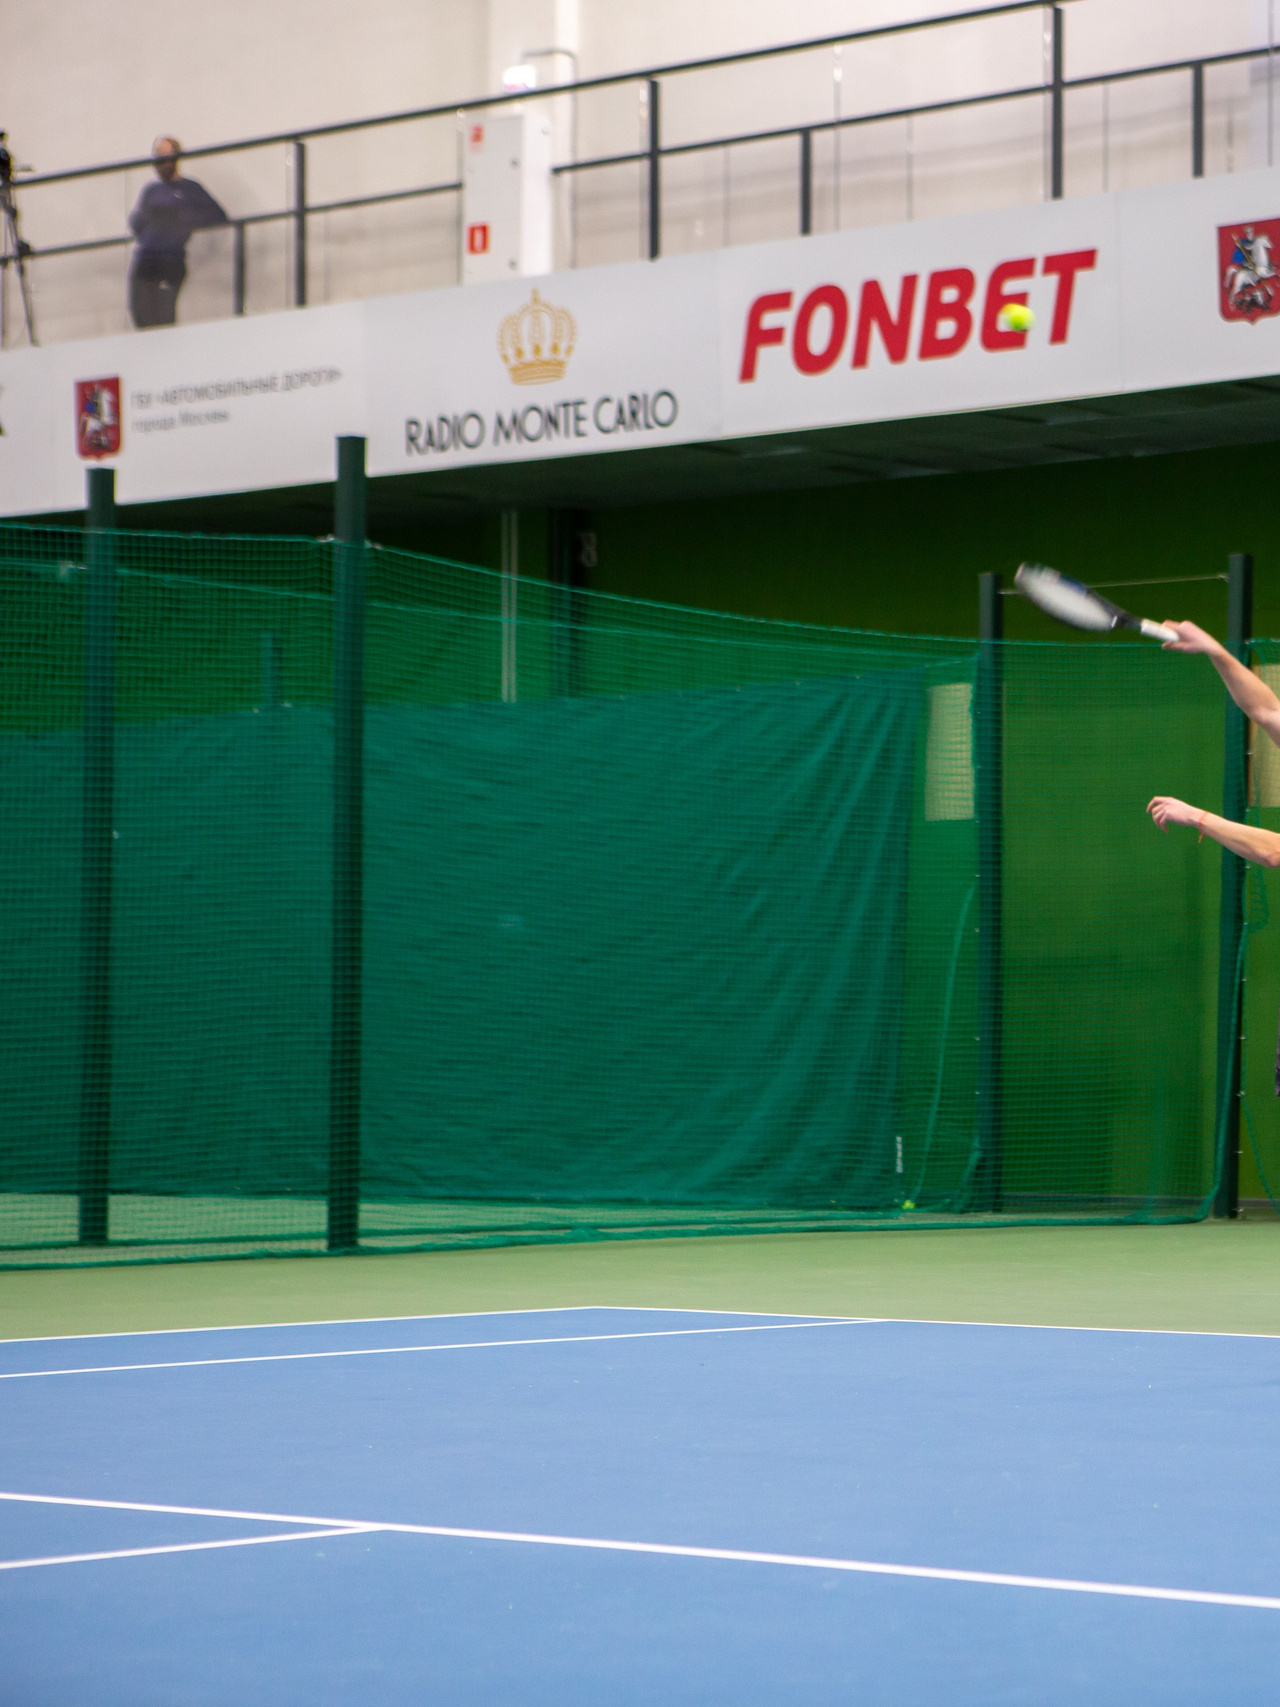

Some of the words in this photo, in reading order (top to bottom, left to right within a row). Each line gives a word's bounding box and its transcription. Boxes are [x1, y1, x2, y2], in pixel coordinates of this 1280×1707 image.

[738, 247, 1098, 384] FONBET
[405, 410, 486, 456] RADIO
[493, 399, 588, 446] MONTE
[593, 388, 679, 434] CARLO
